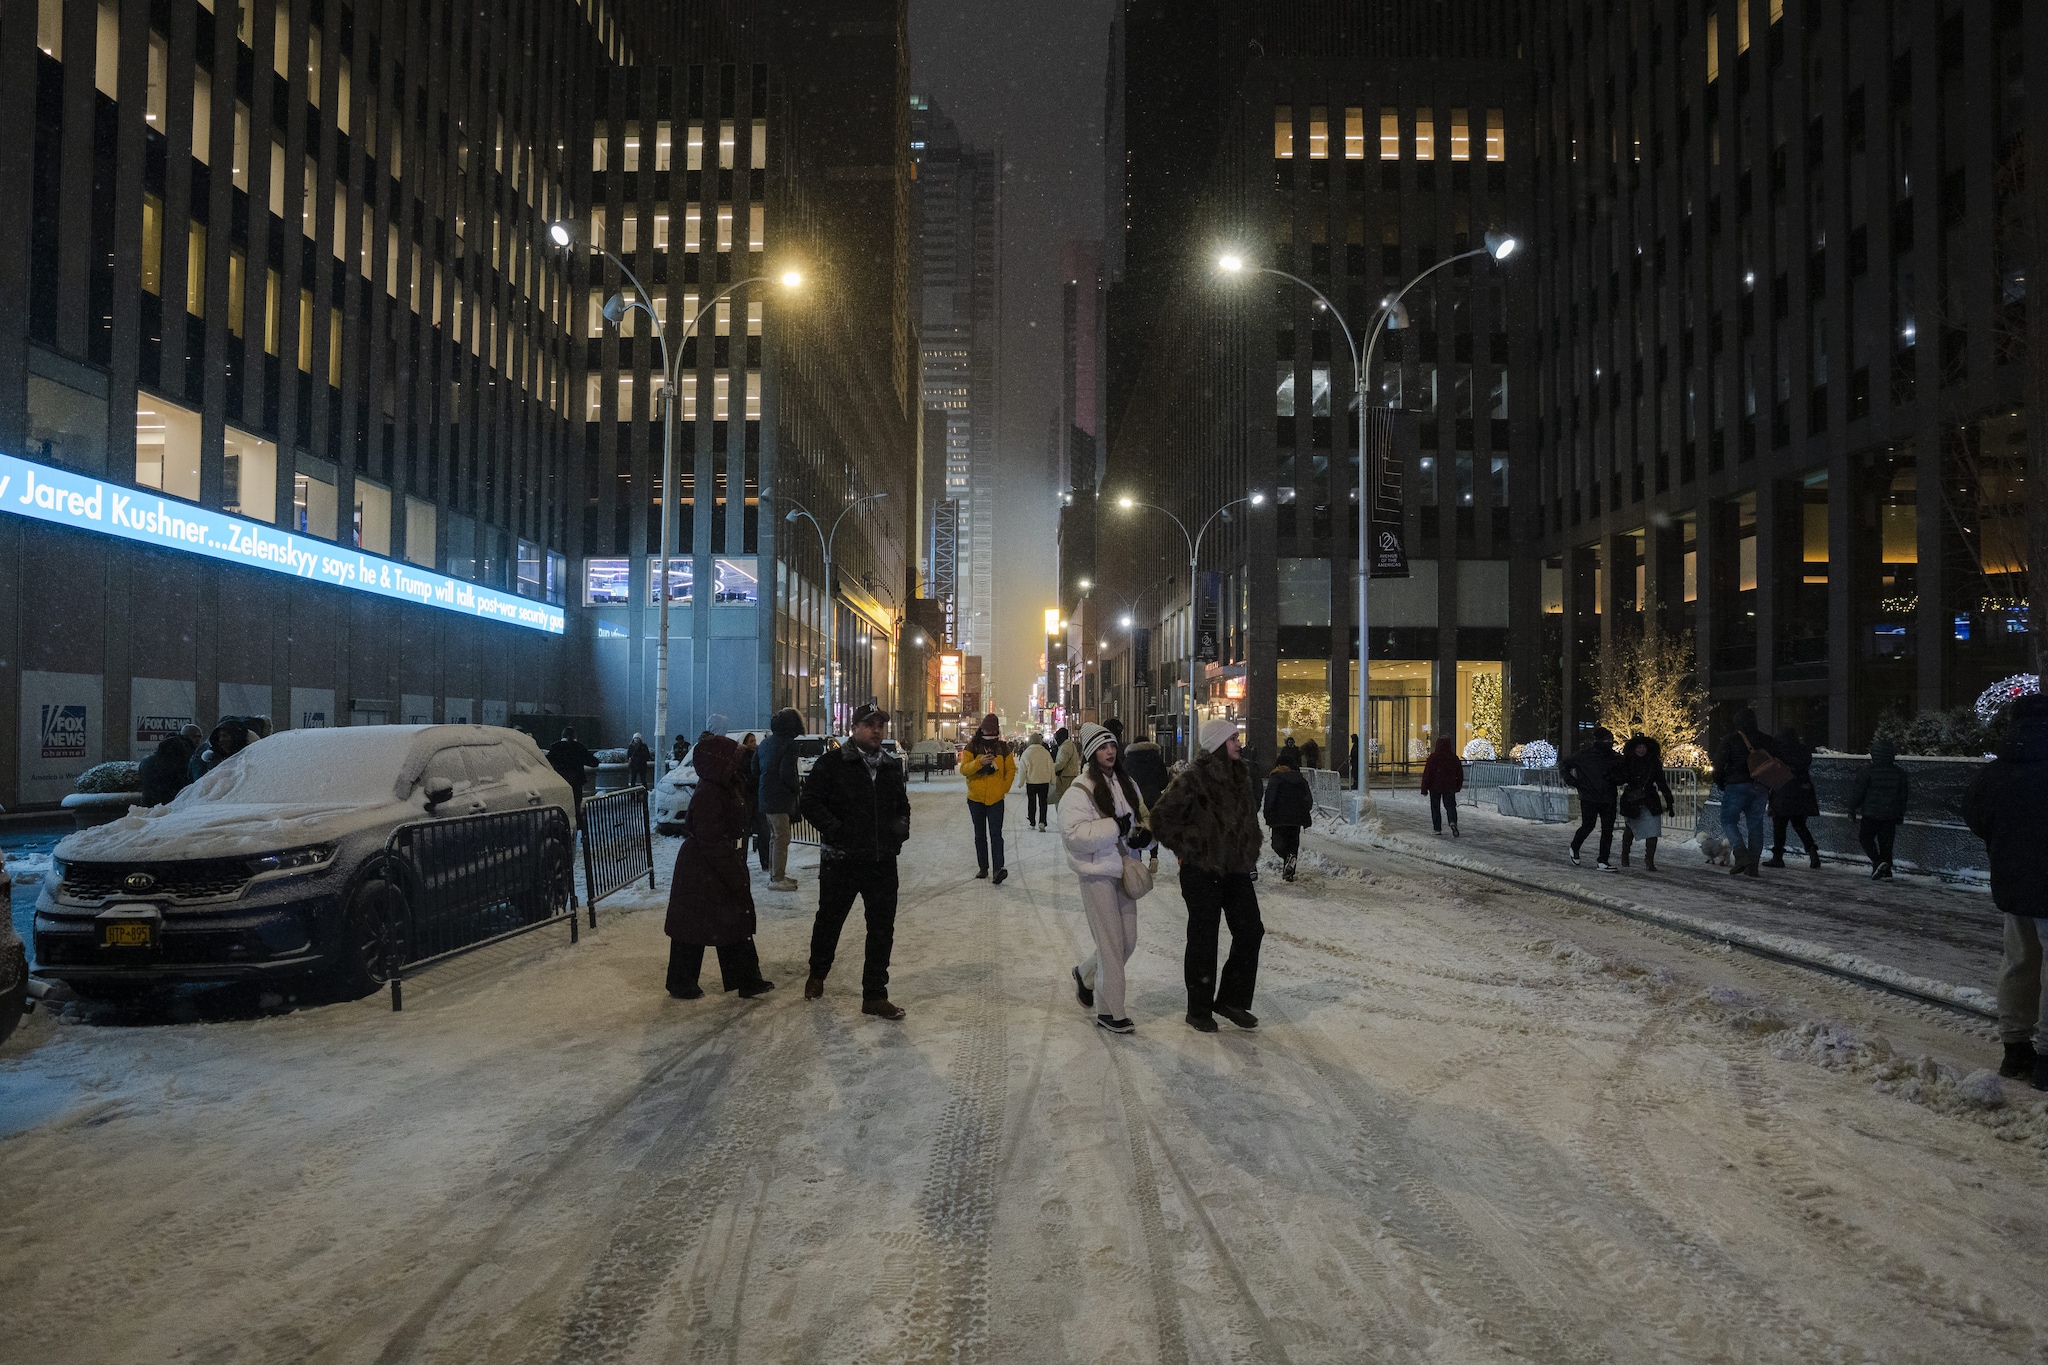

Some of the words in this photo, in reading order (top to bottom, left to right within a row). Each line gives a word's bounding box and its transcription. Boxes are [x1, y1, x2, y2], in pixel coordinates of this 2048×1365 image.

[19, 470, 103, 521] Jared
[322, 555, 355, 585] says
[359, 556, 377, 585] he
[380, 564, 391, 589] &
[394, 568, 432, 604] Trump
[434, 580, 454, 603] will
[456, 585, 475, 609] talk
[477, 596, 517, 618] post-war
[518, 606, 549, 630] security
[945, 594, 953, 644] JONES
[56, 716, 85, 731] FOX
[144, 718, 163, 730] FOX
[48, 732, 85, 747] NEWS
[127, 877, 148, 887] KIA
